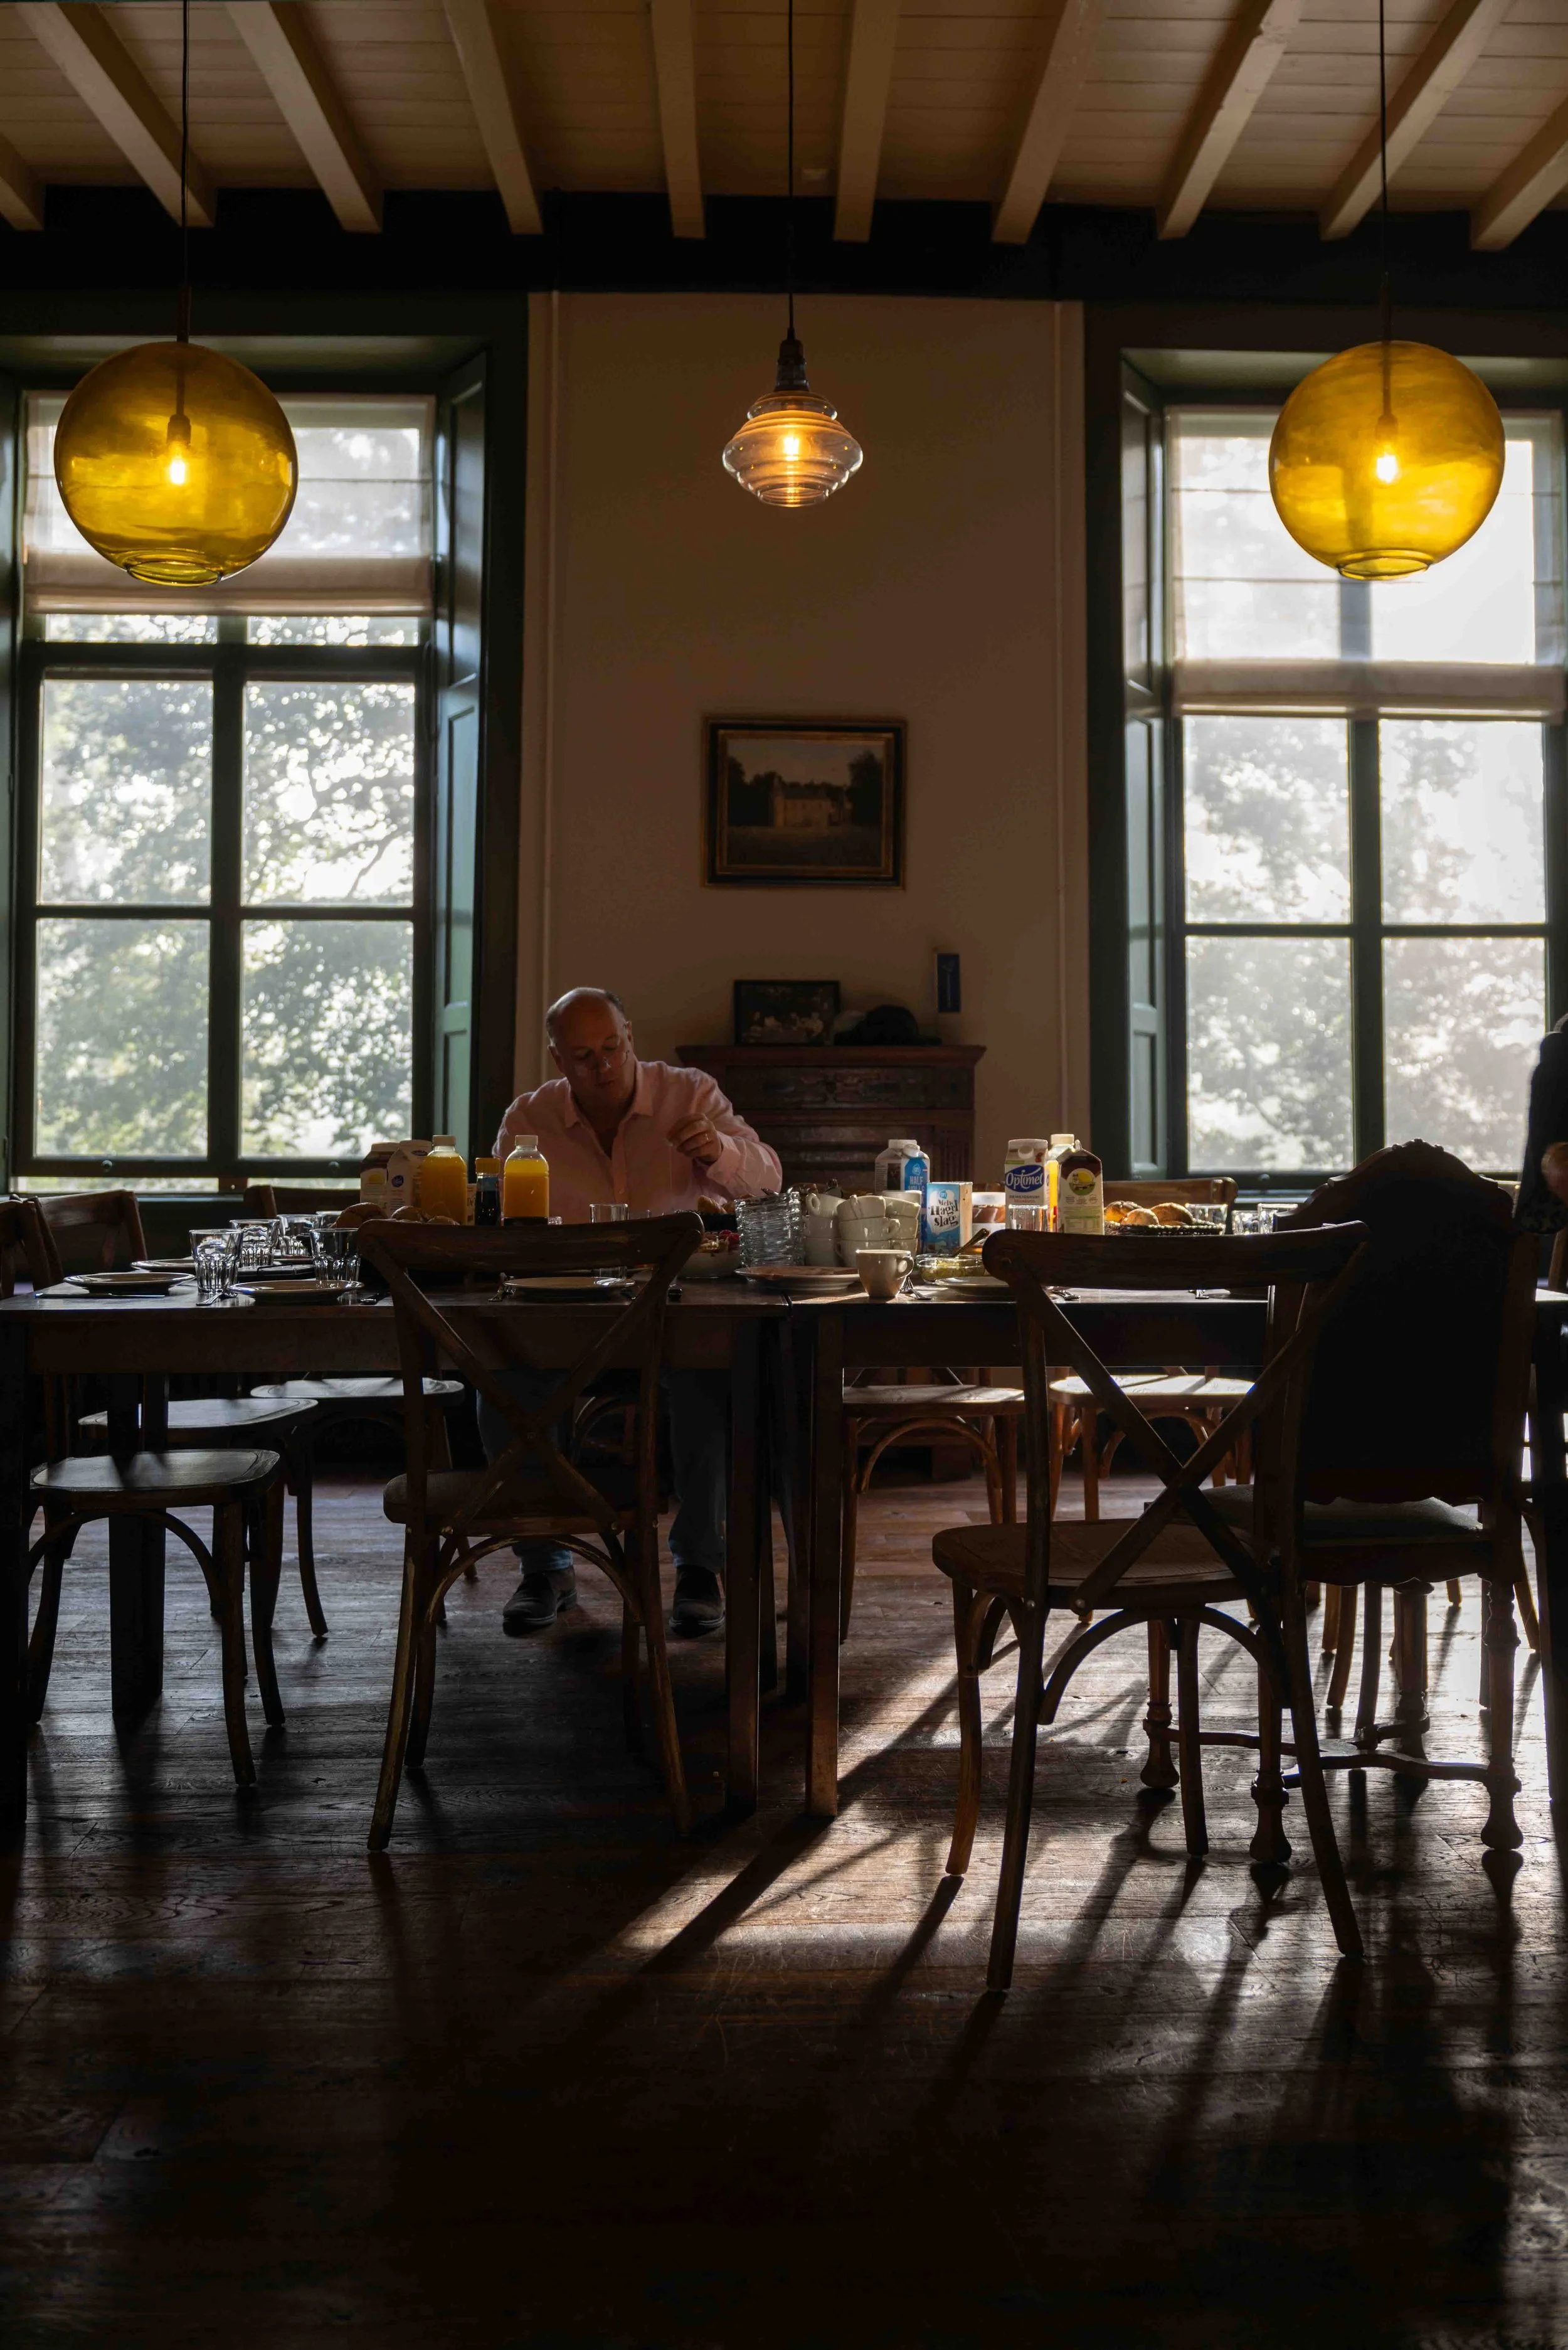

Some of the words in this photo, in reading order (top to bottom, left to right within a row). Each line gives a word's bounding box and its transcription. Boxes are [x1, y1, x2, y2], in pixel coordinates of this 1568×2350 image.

[909, 1175, 923, 1185] HALF
[1005, 1167, 1043, 1190] Optimel
[934, 1215, 959, 1228] slag
